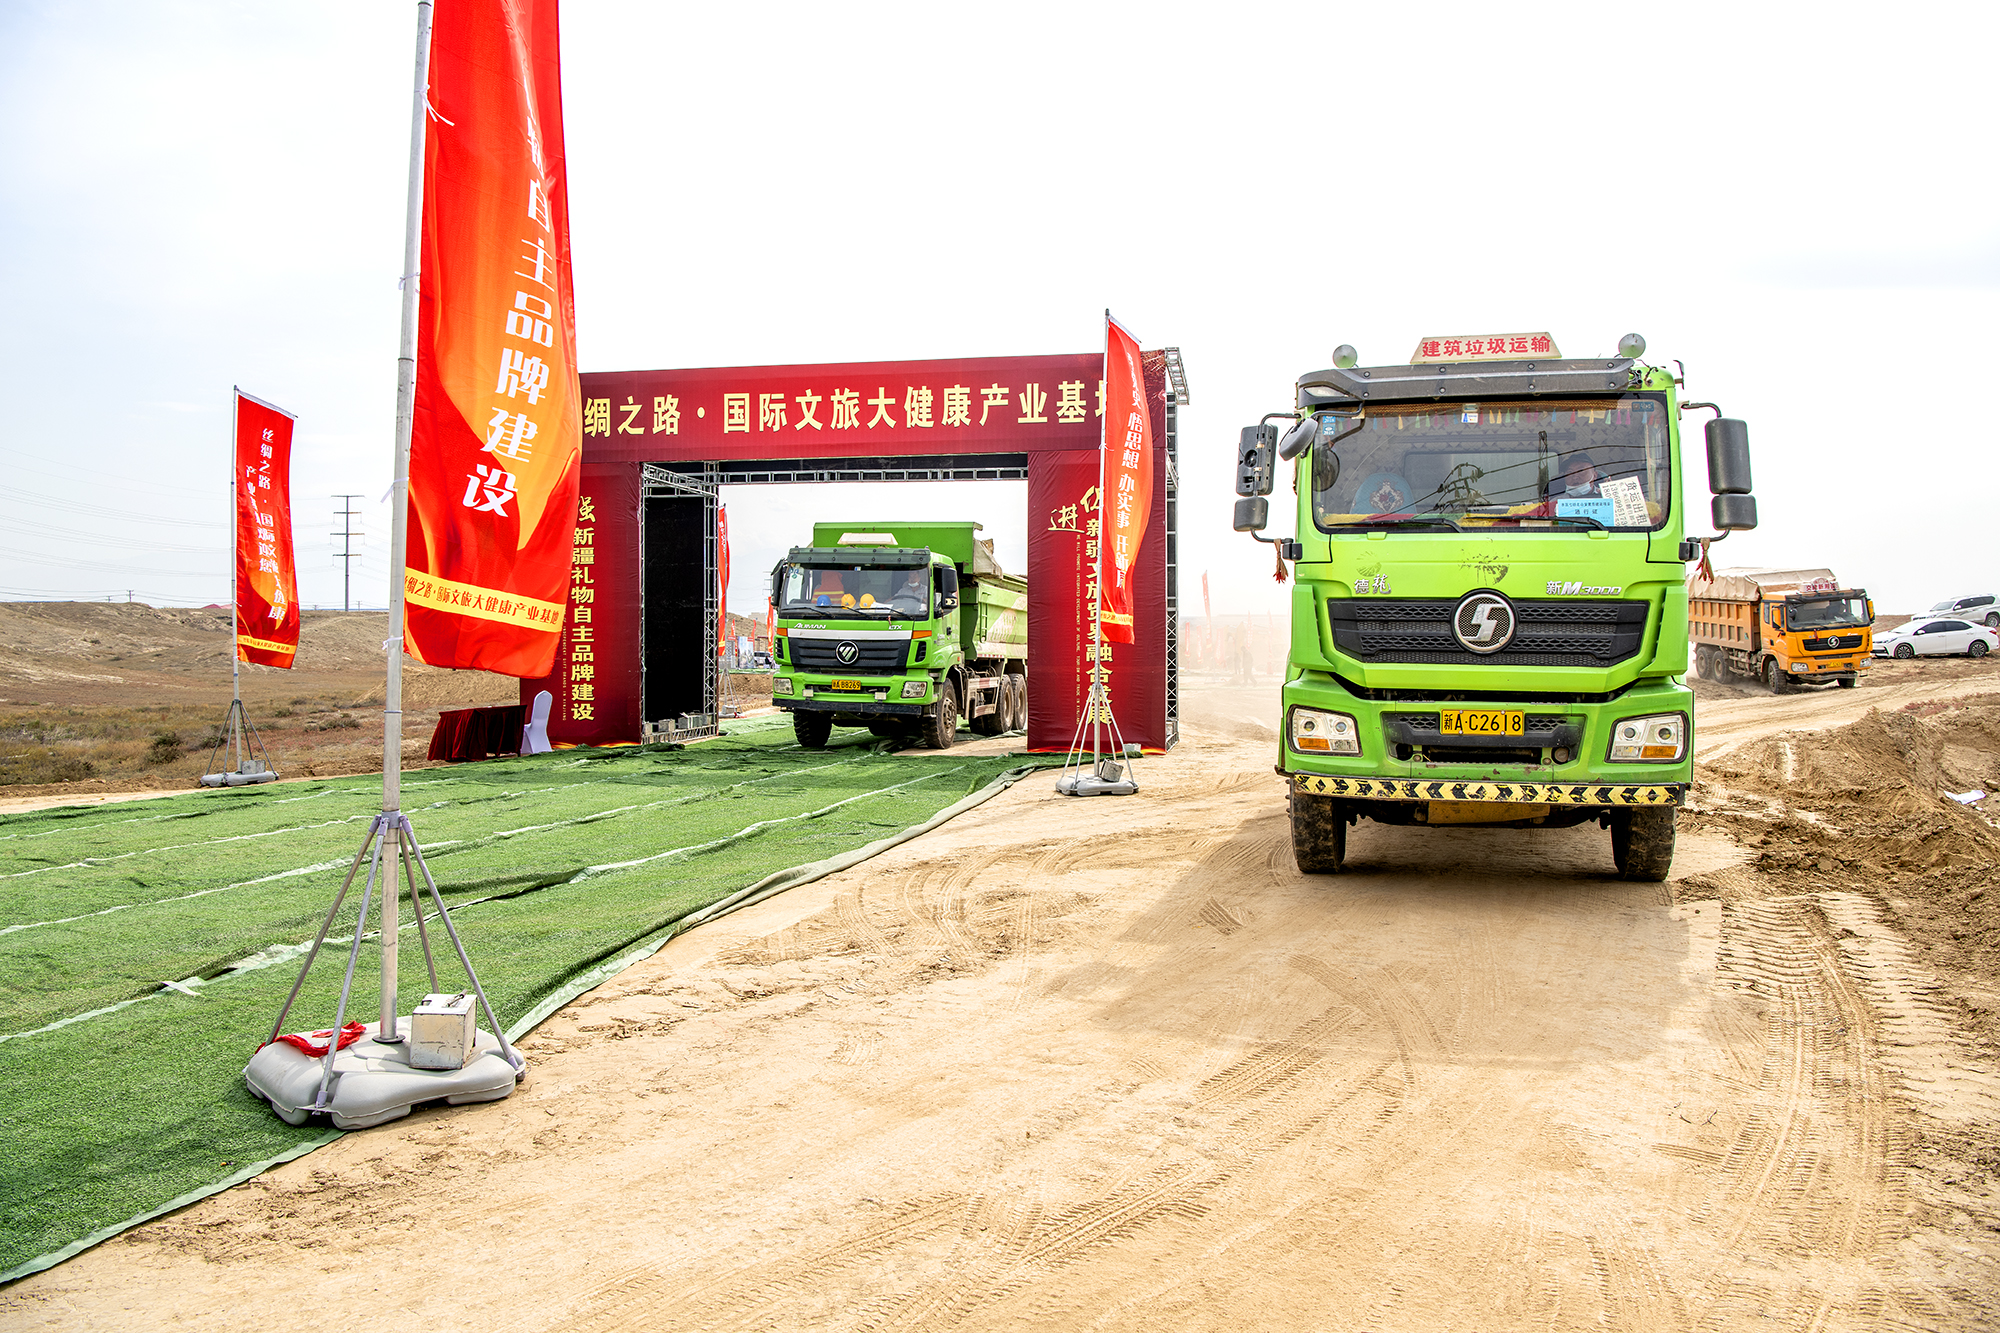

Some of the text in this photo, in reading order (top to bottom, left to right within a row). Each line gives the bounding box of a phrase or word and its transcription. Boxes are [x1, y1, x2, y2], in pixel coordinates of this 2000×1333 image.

[1422, 335, 1551, 358] 建筑垃圾运输
[1444, 713, 1521, 732] 新A·C2618
